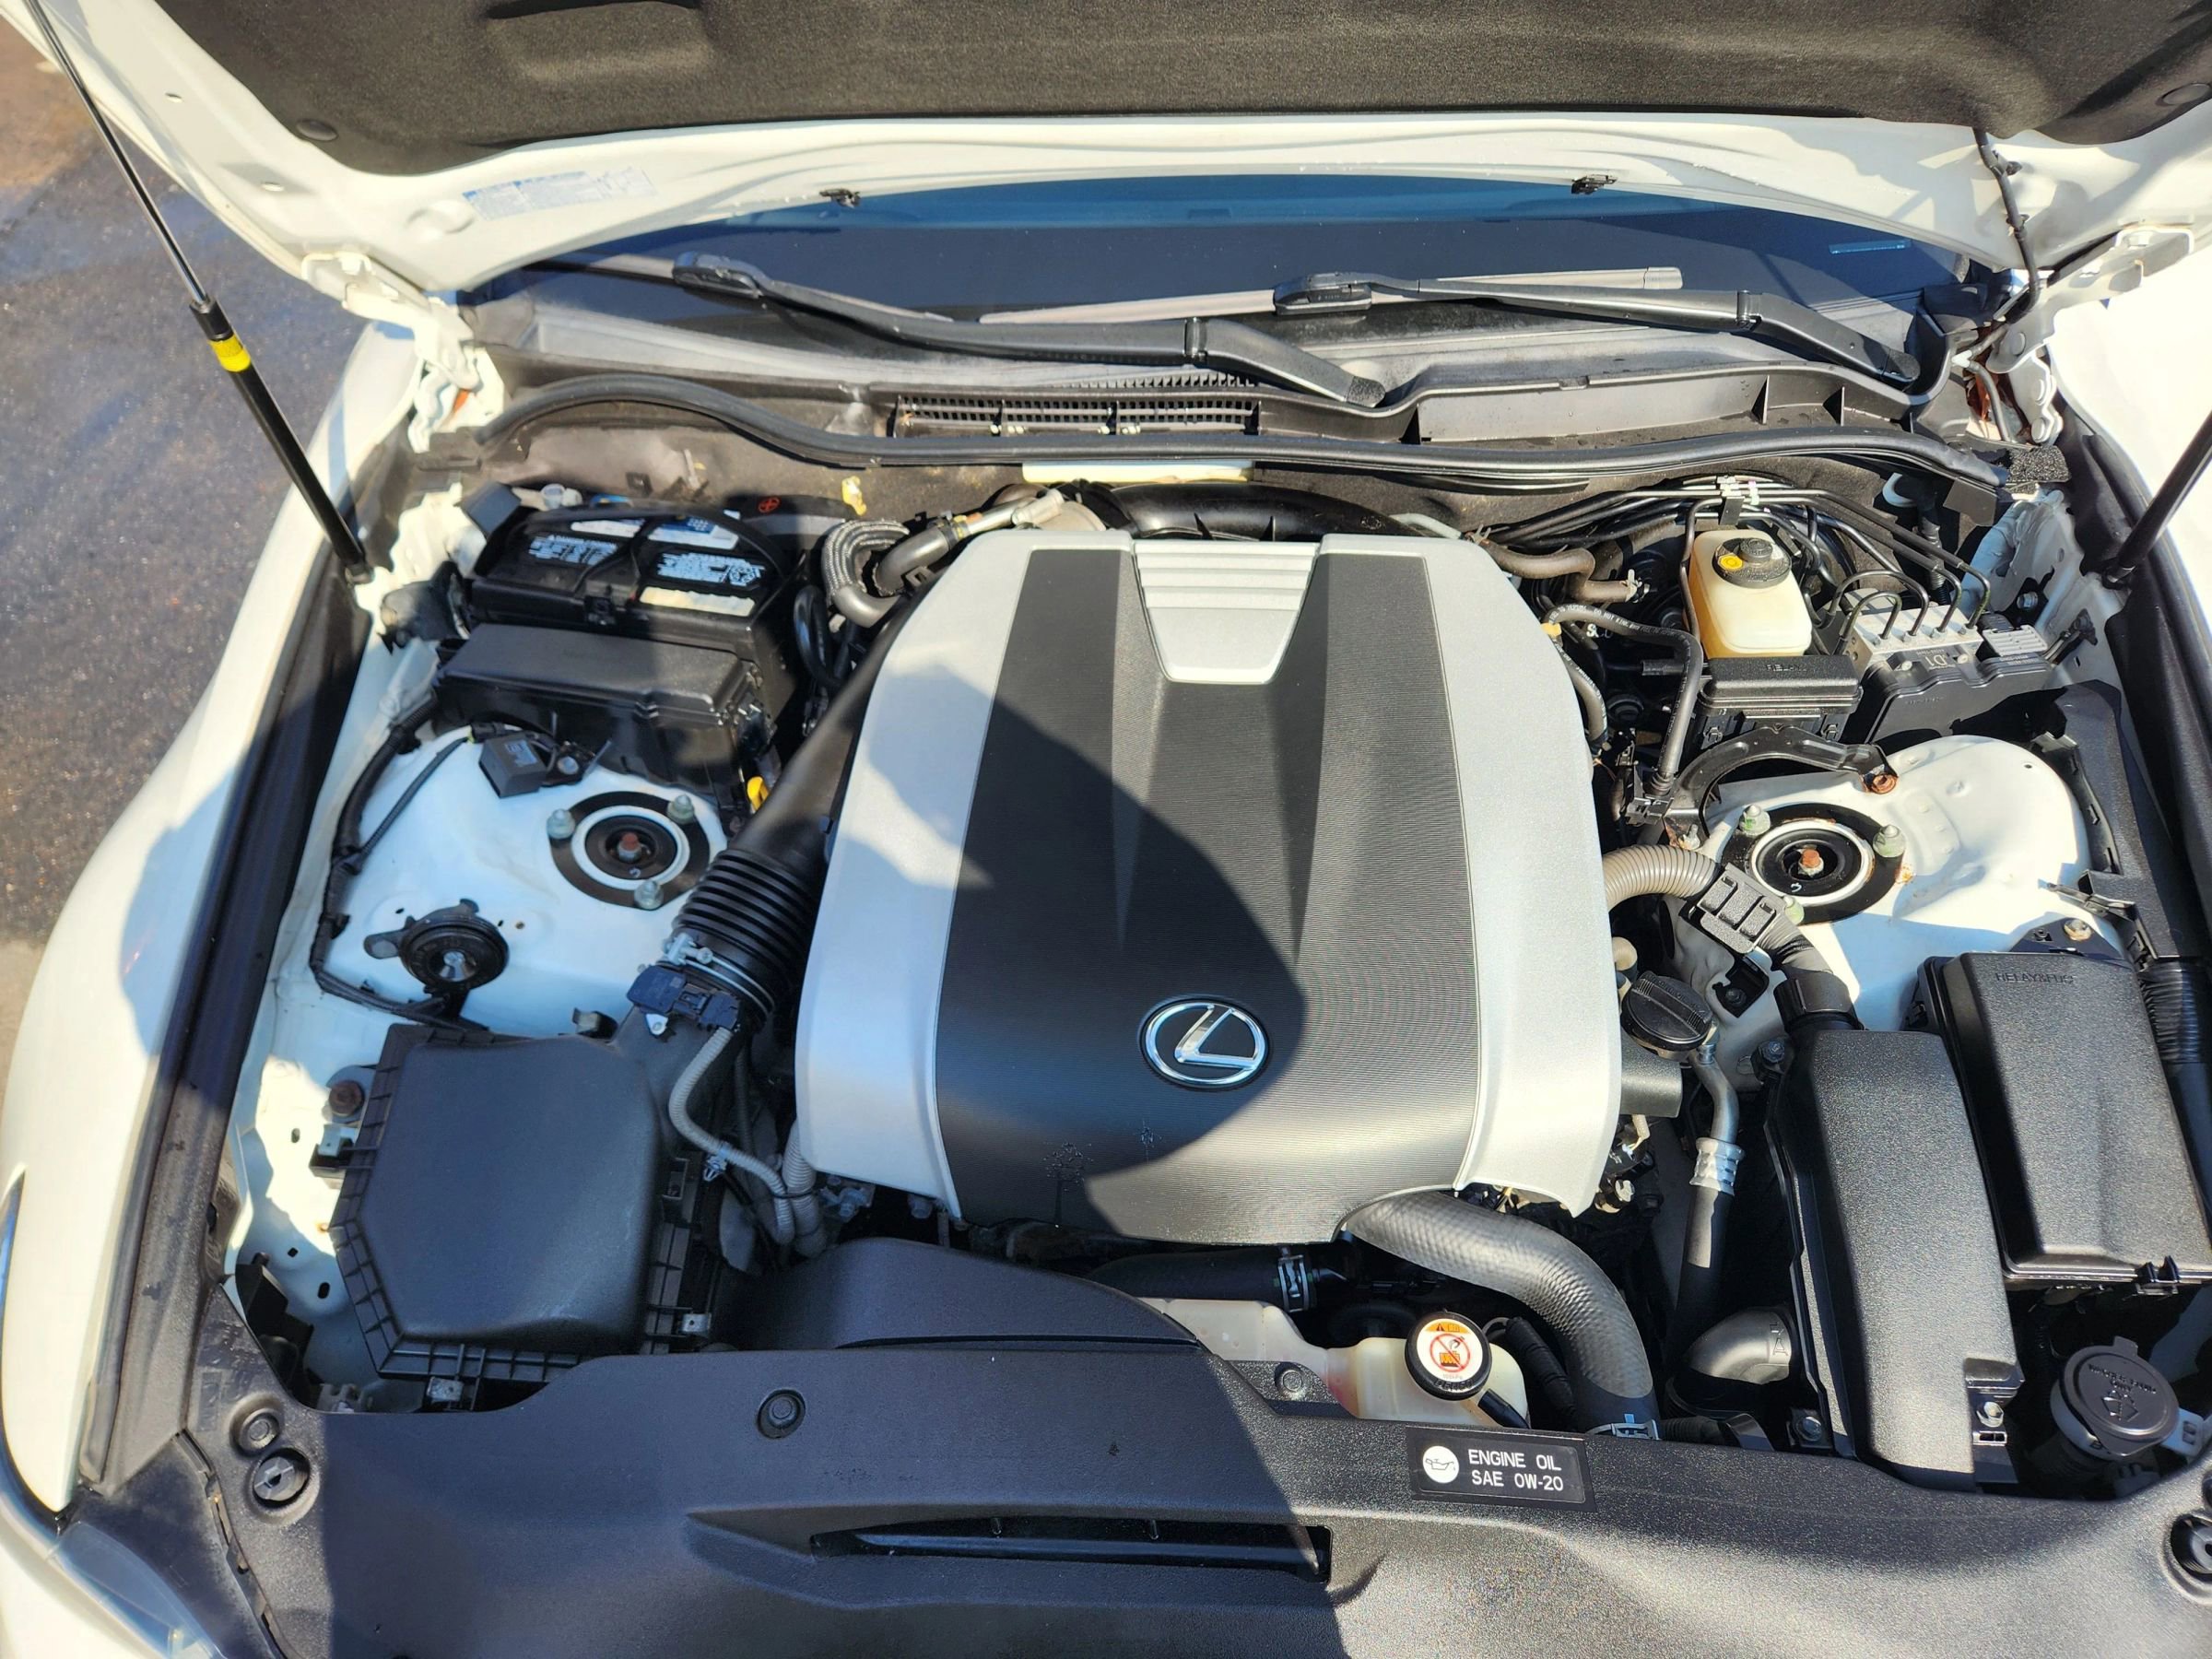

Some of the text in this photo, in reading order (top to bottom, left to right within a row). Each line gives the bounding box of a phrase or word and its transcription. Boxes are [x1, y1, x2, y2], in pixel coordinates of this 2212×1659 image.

[1467, 1449, 1562, 1471] ENGINE OIL
[1471, 1470, 1564, 1491] SAE 0W-20
